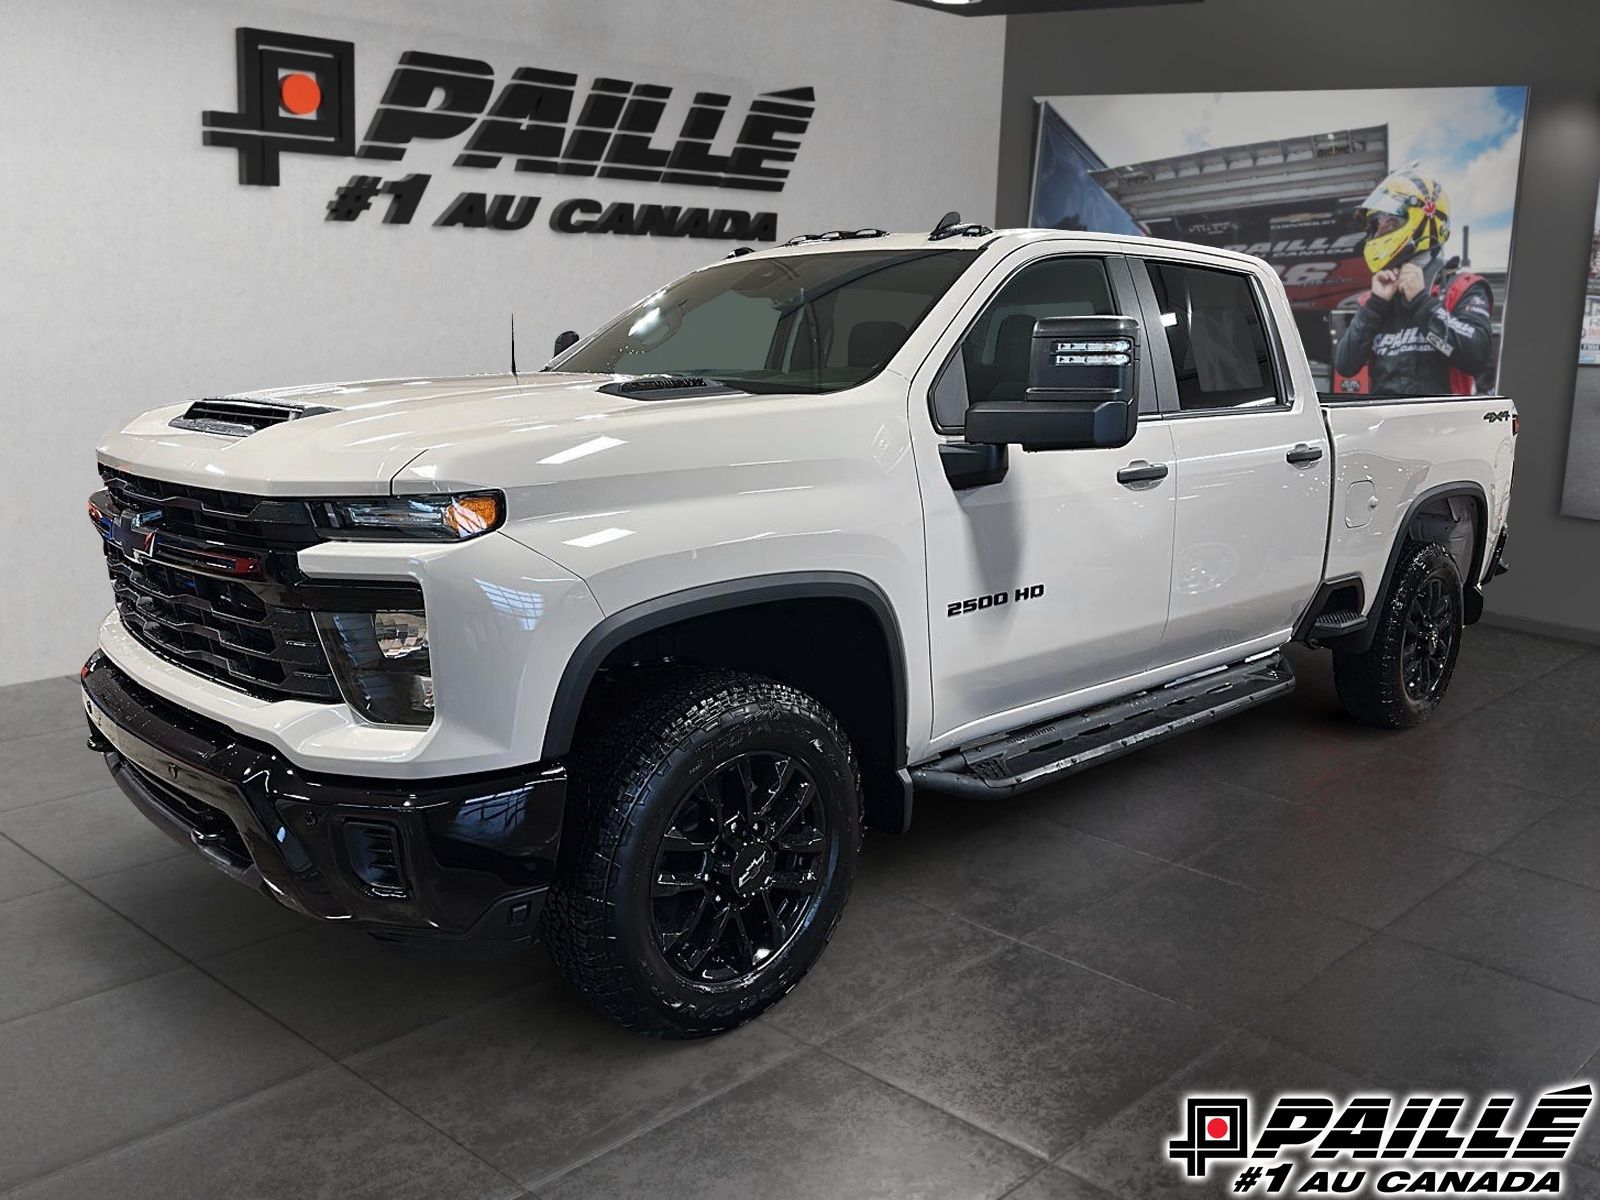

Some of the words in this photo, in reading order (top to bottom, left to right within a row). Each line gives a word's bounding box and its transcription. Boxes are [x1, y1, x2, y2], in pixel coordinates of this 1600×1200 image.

[355, 51, 815, 192] PAILLÉ
[325, 173, 432, 225] #1
[432, 192, 542, 230] AU
[549, 198, 778, 242] CANADA
[1273, 247, 1355, 258] CANADA
[947, 591, 1008, 617] 2500
[1014, 584, 1045, 602] HD
